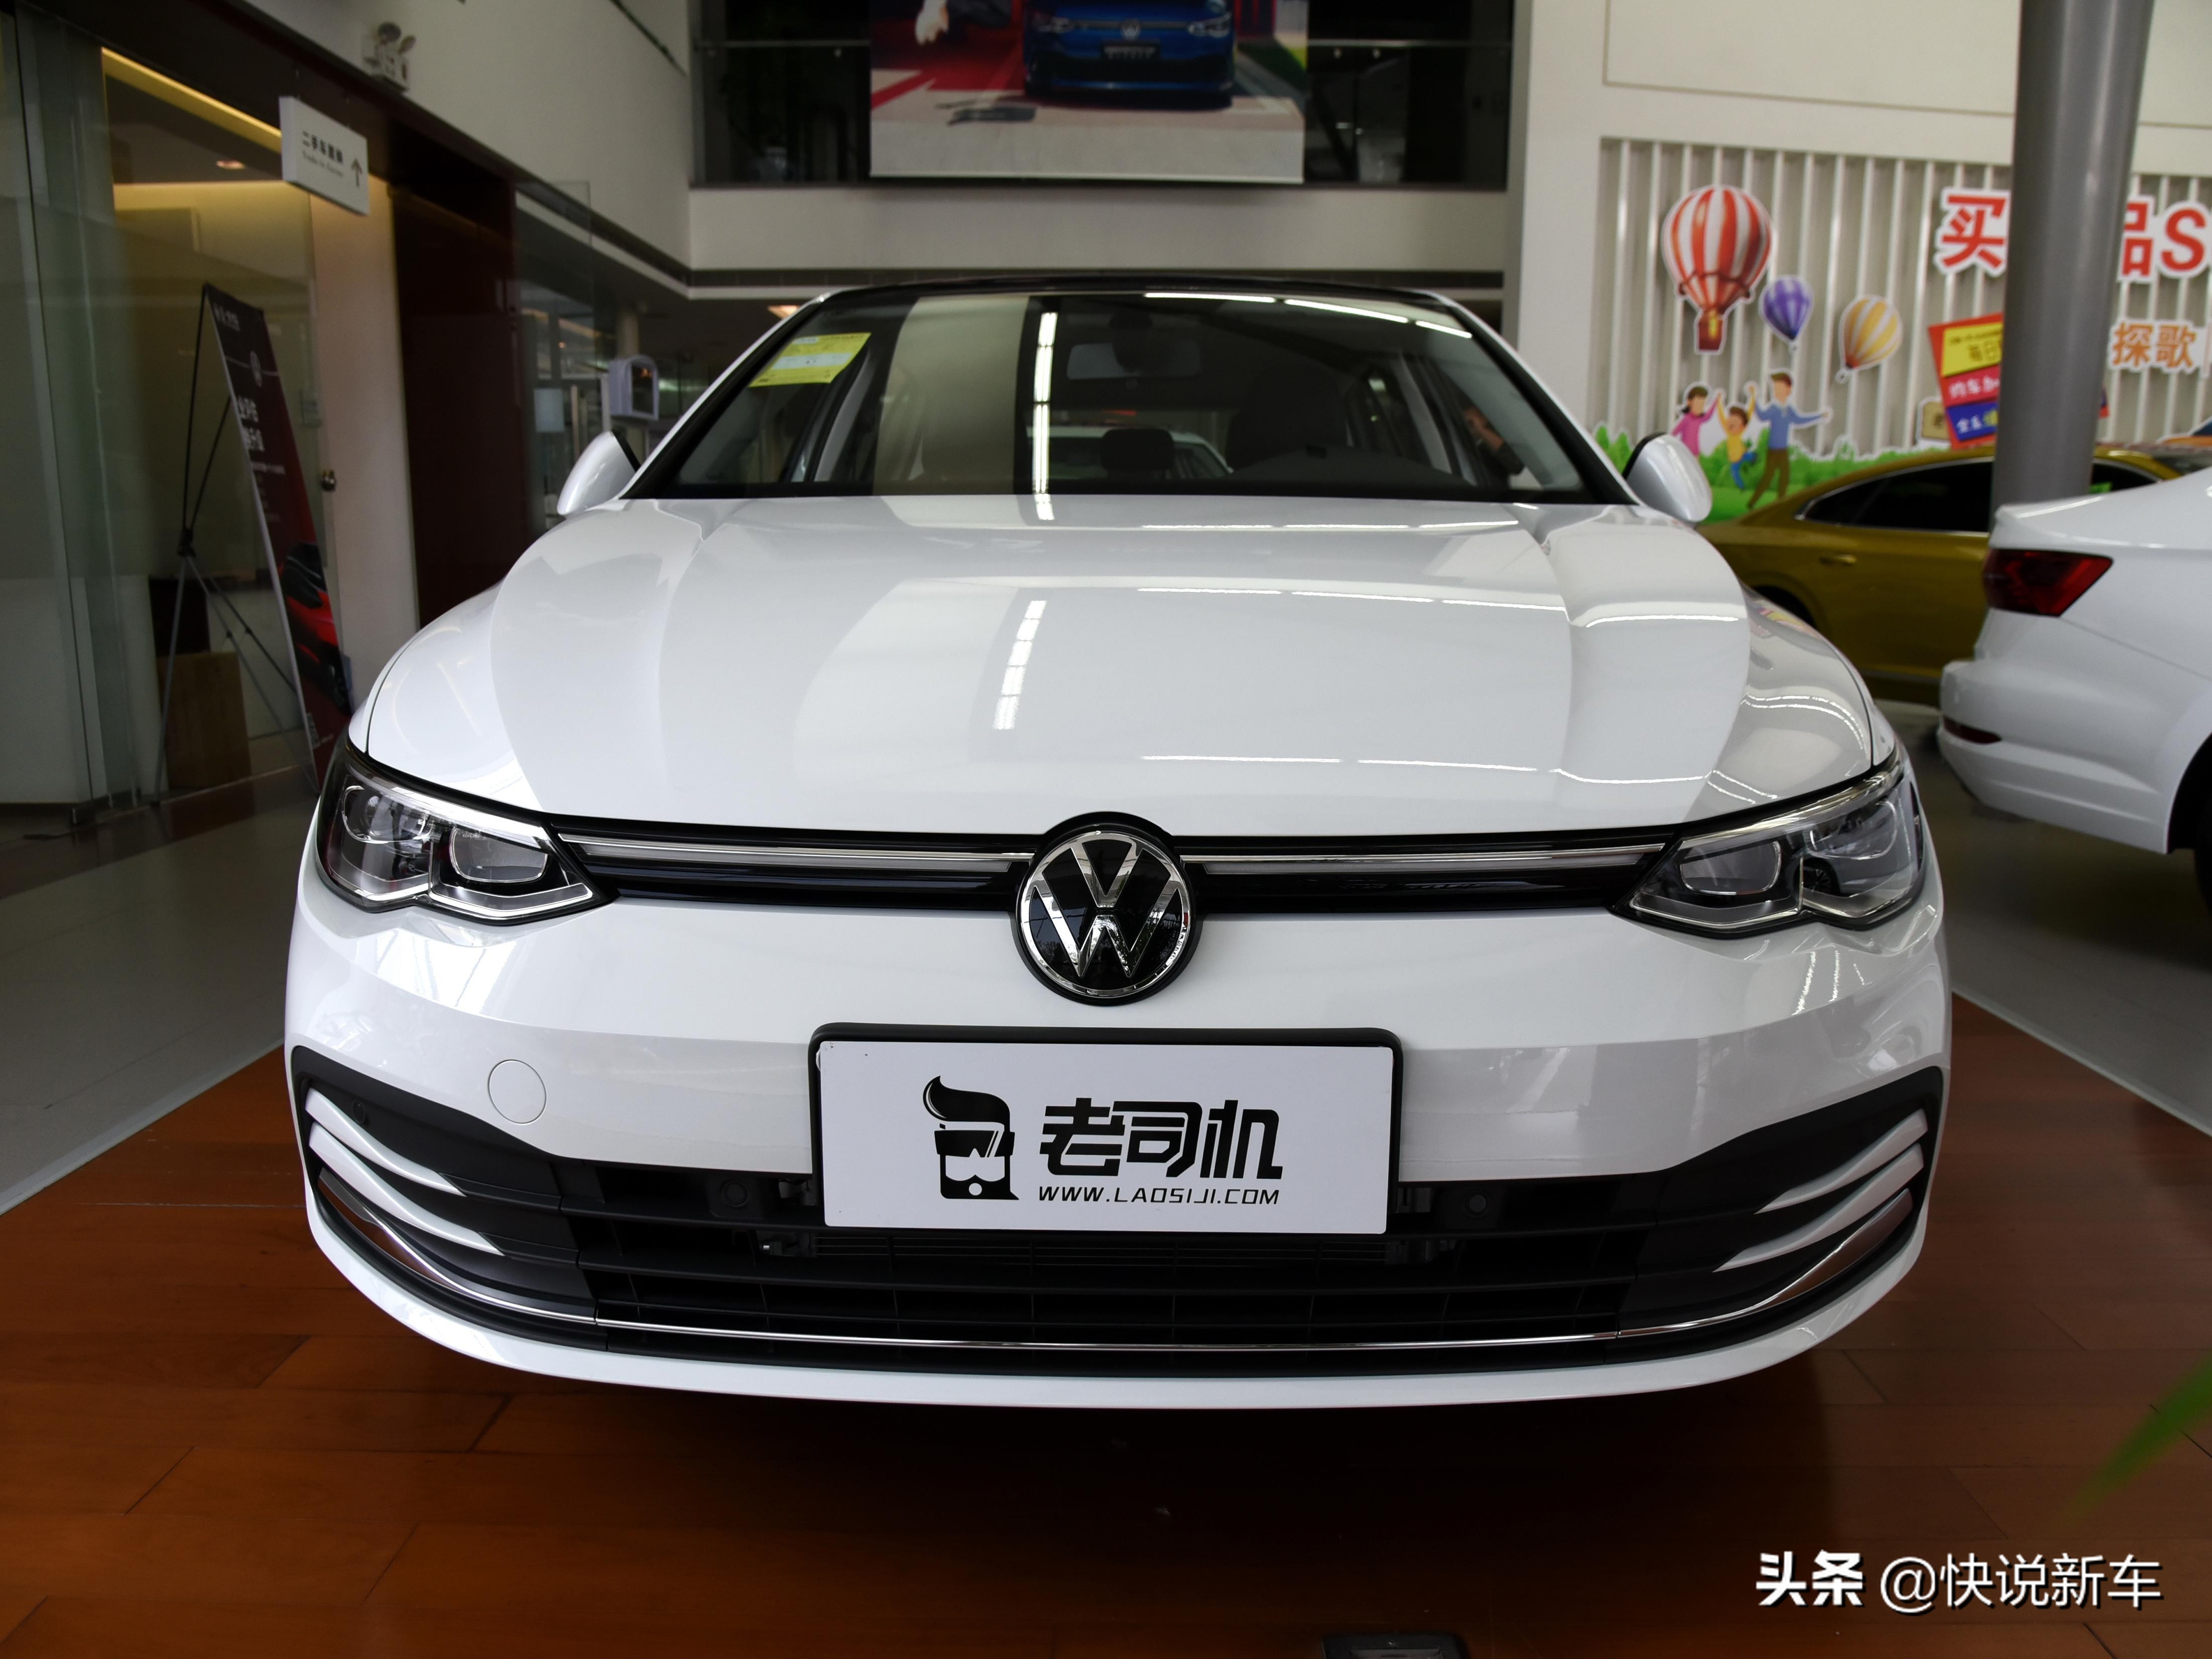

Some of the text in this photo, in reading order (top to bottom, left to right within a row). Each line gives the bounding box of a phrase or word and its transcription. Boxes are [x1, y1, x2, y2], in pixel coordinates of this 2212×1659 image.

[1942, 195, 2006, 268] 买
[2112, 322, 2197, 368] 探歌
[1039, 1097, 1283, 1179] 老司机
[1039, 1185, 1280, 1205] WWW.LAOSIJI.COM
